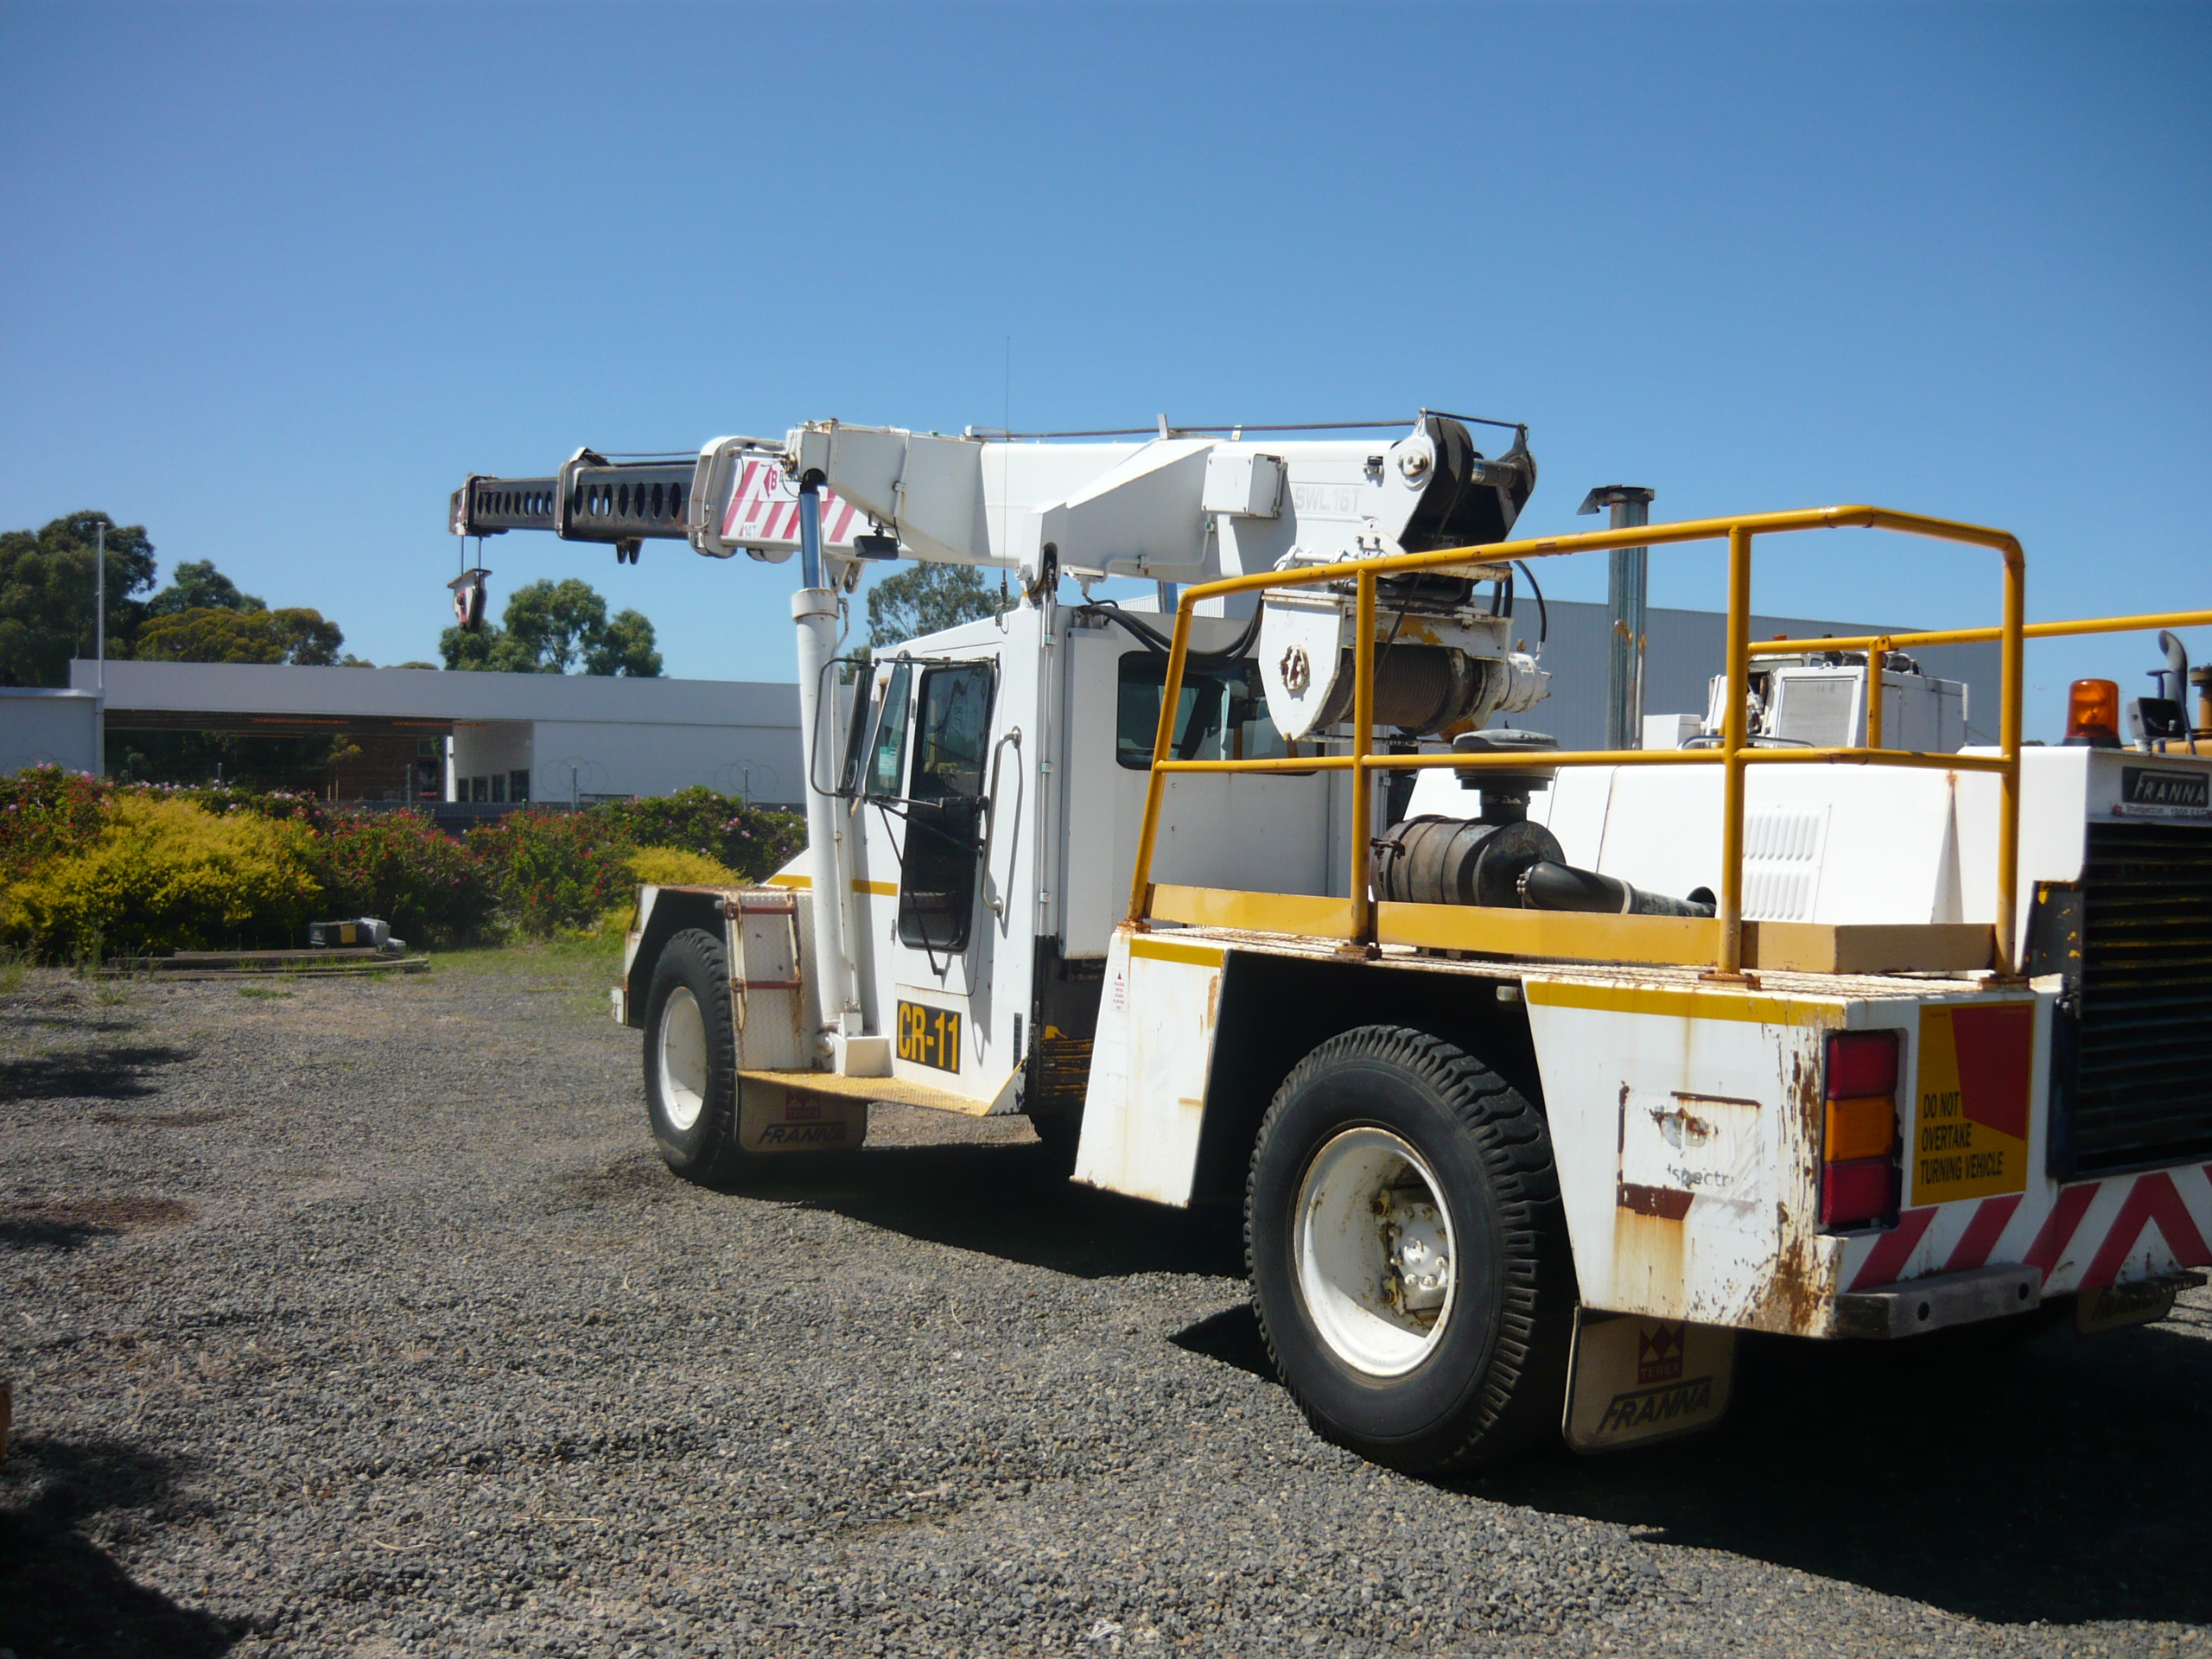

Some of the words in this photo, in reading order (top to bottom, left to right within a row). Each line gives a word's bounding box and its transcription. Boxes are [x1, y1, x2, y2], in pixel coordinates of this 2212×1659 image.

[2133, 771, 2206, 804] FRANNA
[898, 1001, 958, 1071] CR-11
[1923, 1093, 1937, 1119] DO
[1940, 1090, 1960, 1117] NOT
[1921, 1122, 1973, 1152] OVERTAKE
[1920, 1155, 1962, 1185] TURNING
[1965, 1150, 2004, 1179] VEHICLE
[1641, 1363, 1681, 1379] TEREX
[1597, 1375, 1713, 1434] FRANNA
